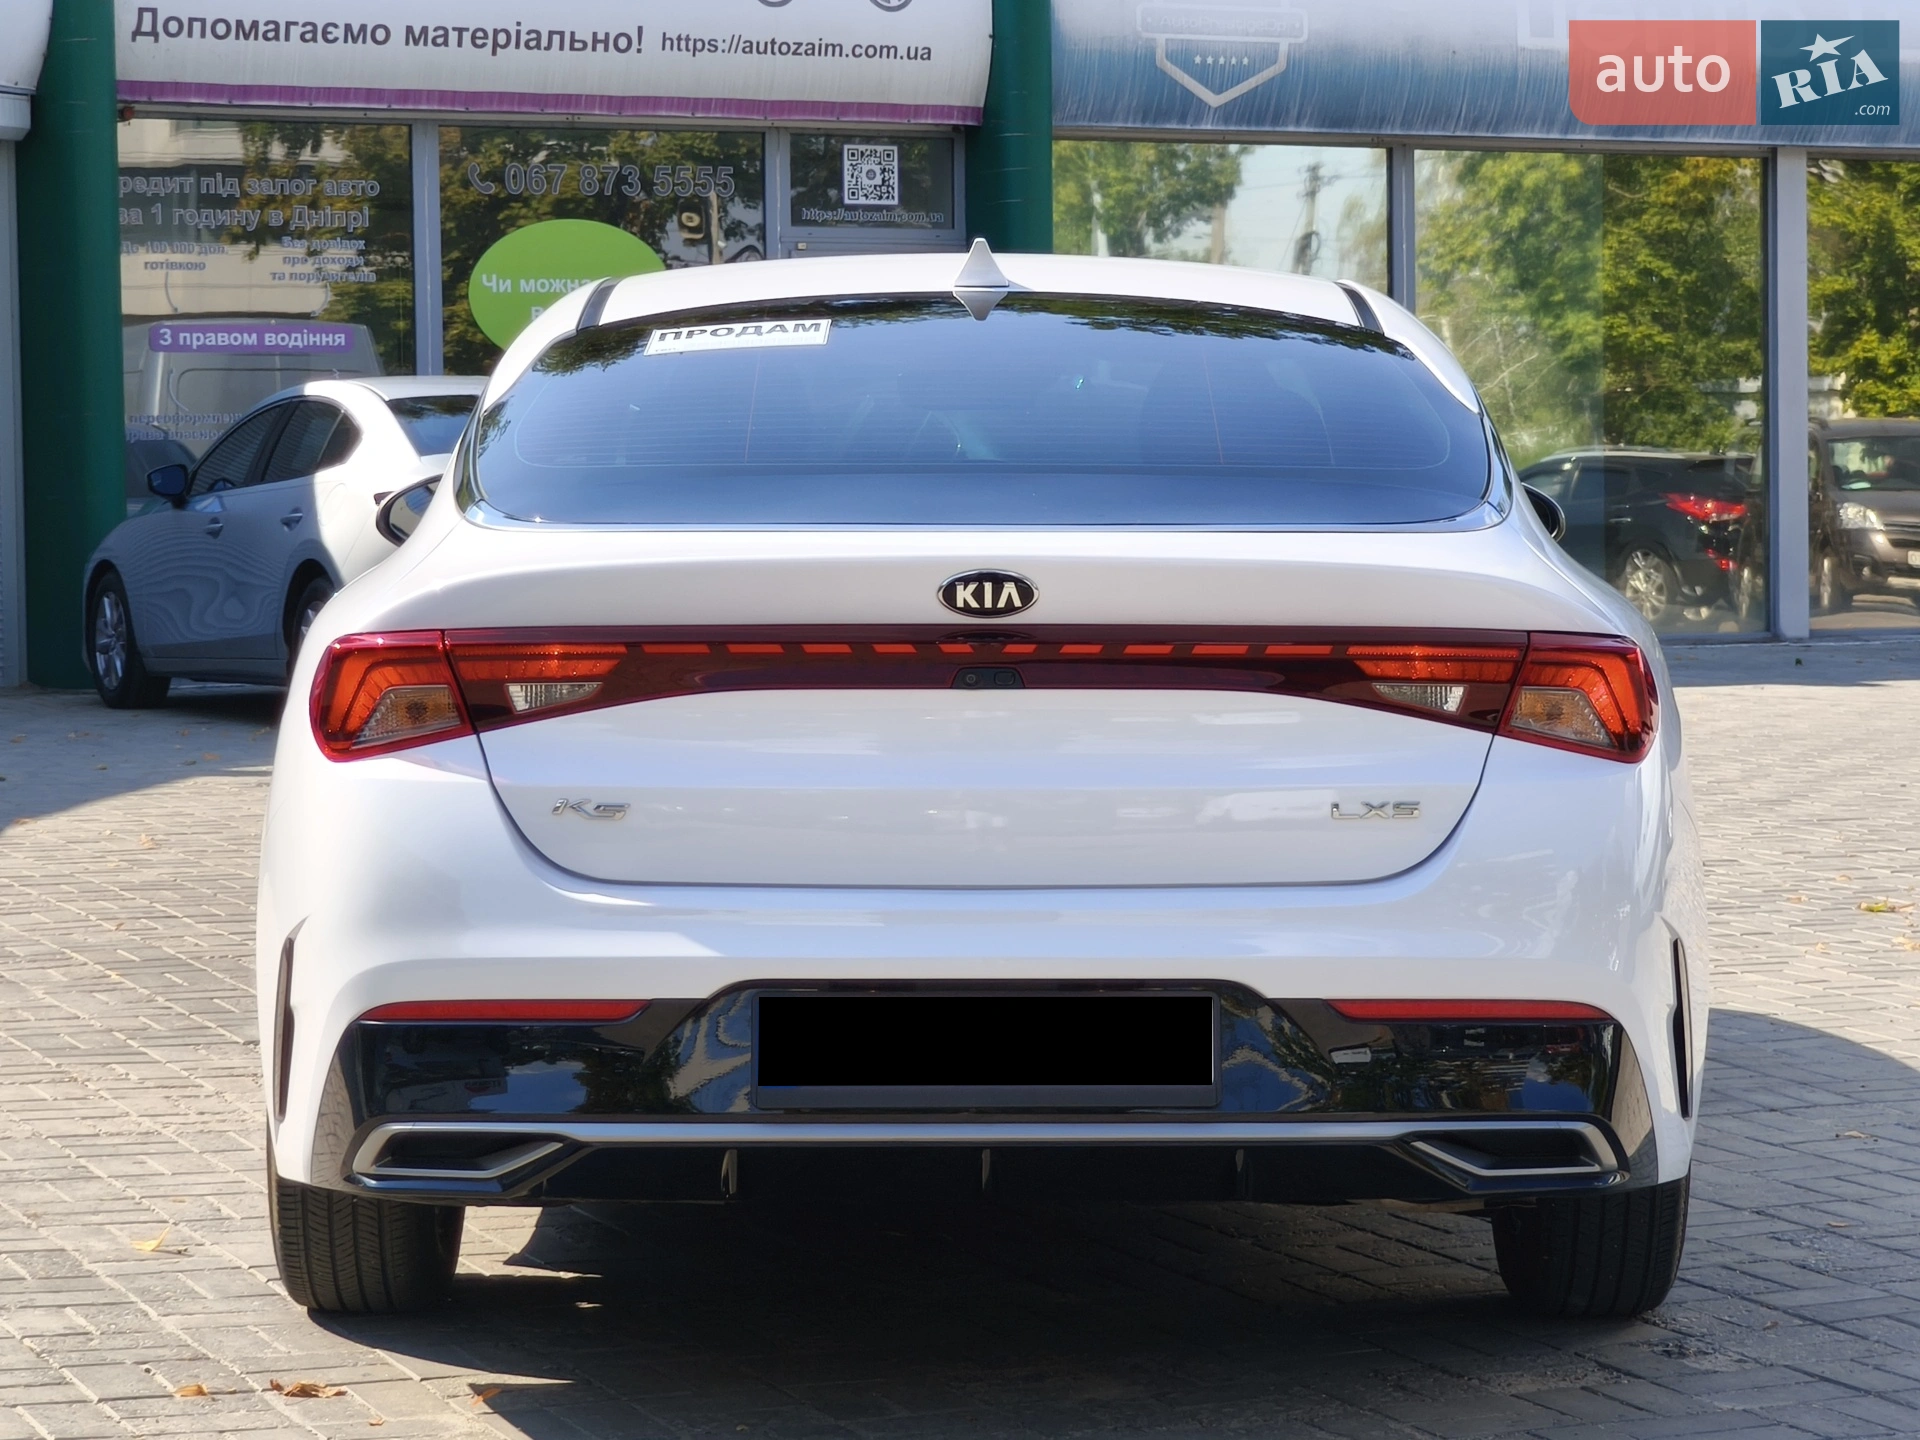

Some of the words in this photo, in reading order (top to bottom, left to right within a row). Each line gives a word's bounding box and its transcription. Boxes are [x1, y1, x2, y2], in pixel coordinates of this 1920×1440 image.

[131, 7, 391, 46] Допомагаємо
[404, 21, 644, 57] матеріально!
[661, 32, 933, 61] https://autozaim.com.ua
[200, 173, 240, 197] під
[247, 178, 317, 196] залог
[324, 179, 381, 197] авто
[504, 163, 567, 195] 067
[579, 164, 642, 196] 873
[653, 166, 735, 197] 5555
[151, 202, 162, 225] 1
[172, 207, 261, 231] годину
[268, 209, 283, 226] в
[289, 205, 370, 232] Дніпрі
[801, 207, 944, 223] https://autozaim.com.ua
[281, 236, 307, 249] Без
[144, 258, 207, 271] готівкою
[282, 256, 309, 267] про
[312, 256, 365, 268] доходи
[270, 272, 286, 281] та
[481, 274, 512, 293] Чи
[520, 279, 590, 293] можн
[179, 332, 257, 349] правом
[264, 331, 346, 348] водіння
[658, 323, 822, 341] ПРОДАМ
[955, 581, 1022, 608] KIA
[552, 798, 630, 820] K5
[1331, 801, 1420, 819] LXS
